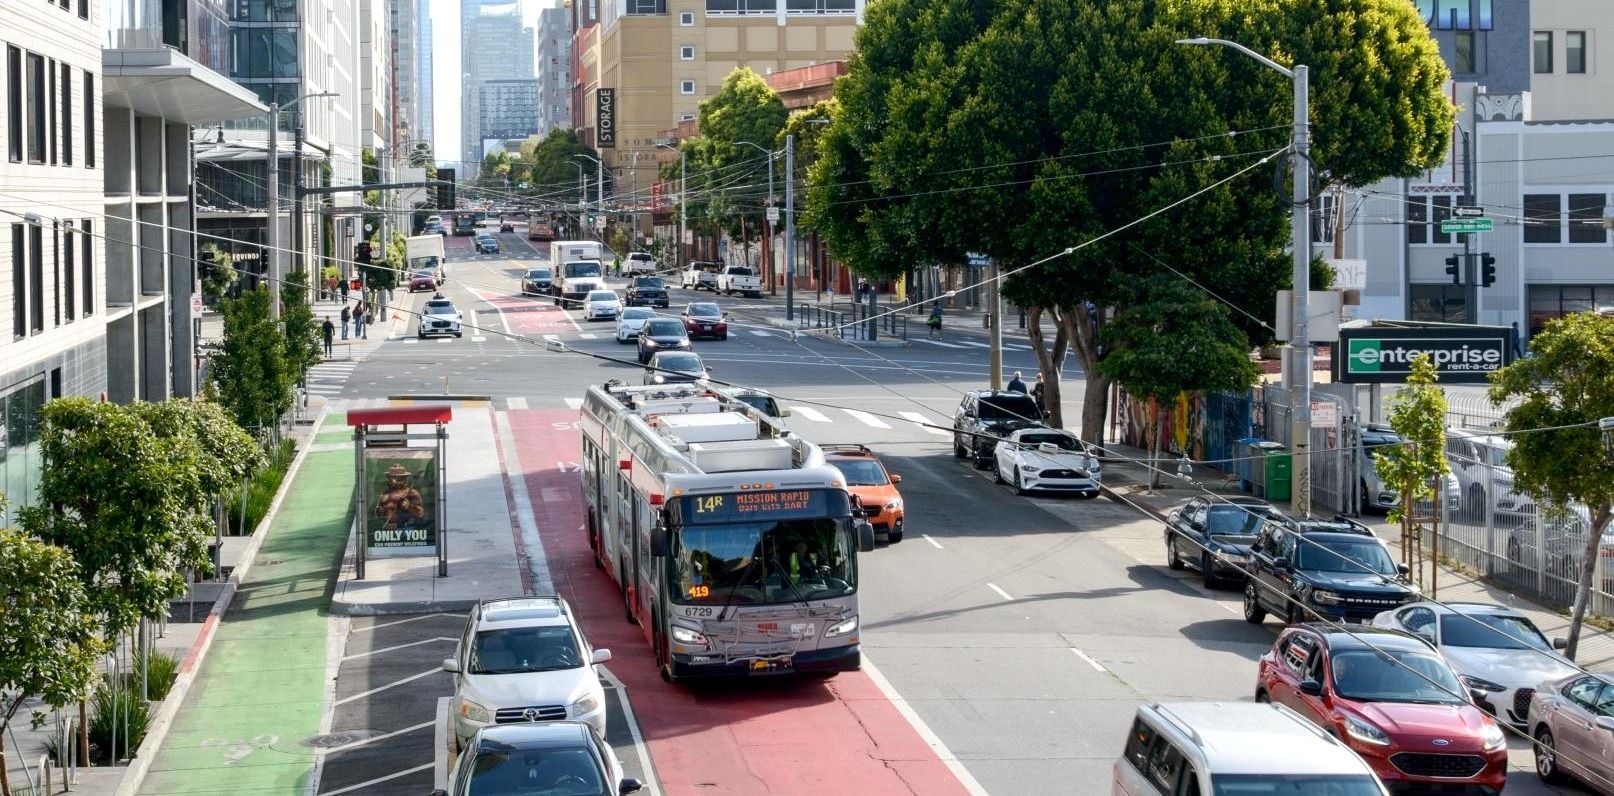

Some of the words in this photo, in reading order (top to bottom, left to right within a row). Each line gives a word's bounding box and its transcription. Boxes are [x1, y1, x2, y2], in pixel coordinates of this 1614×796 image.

[600, 90, 612, 141] STORAGE
[737, 493, 777, 504] MISSION
[781, 491, 809, 501] RAPID
[374, 530, 402, 541] ONLY
[404, 529, 427, 541] YOU
[688, 586, 709, 597] 419
[685, 607, 712, 617] 6729
